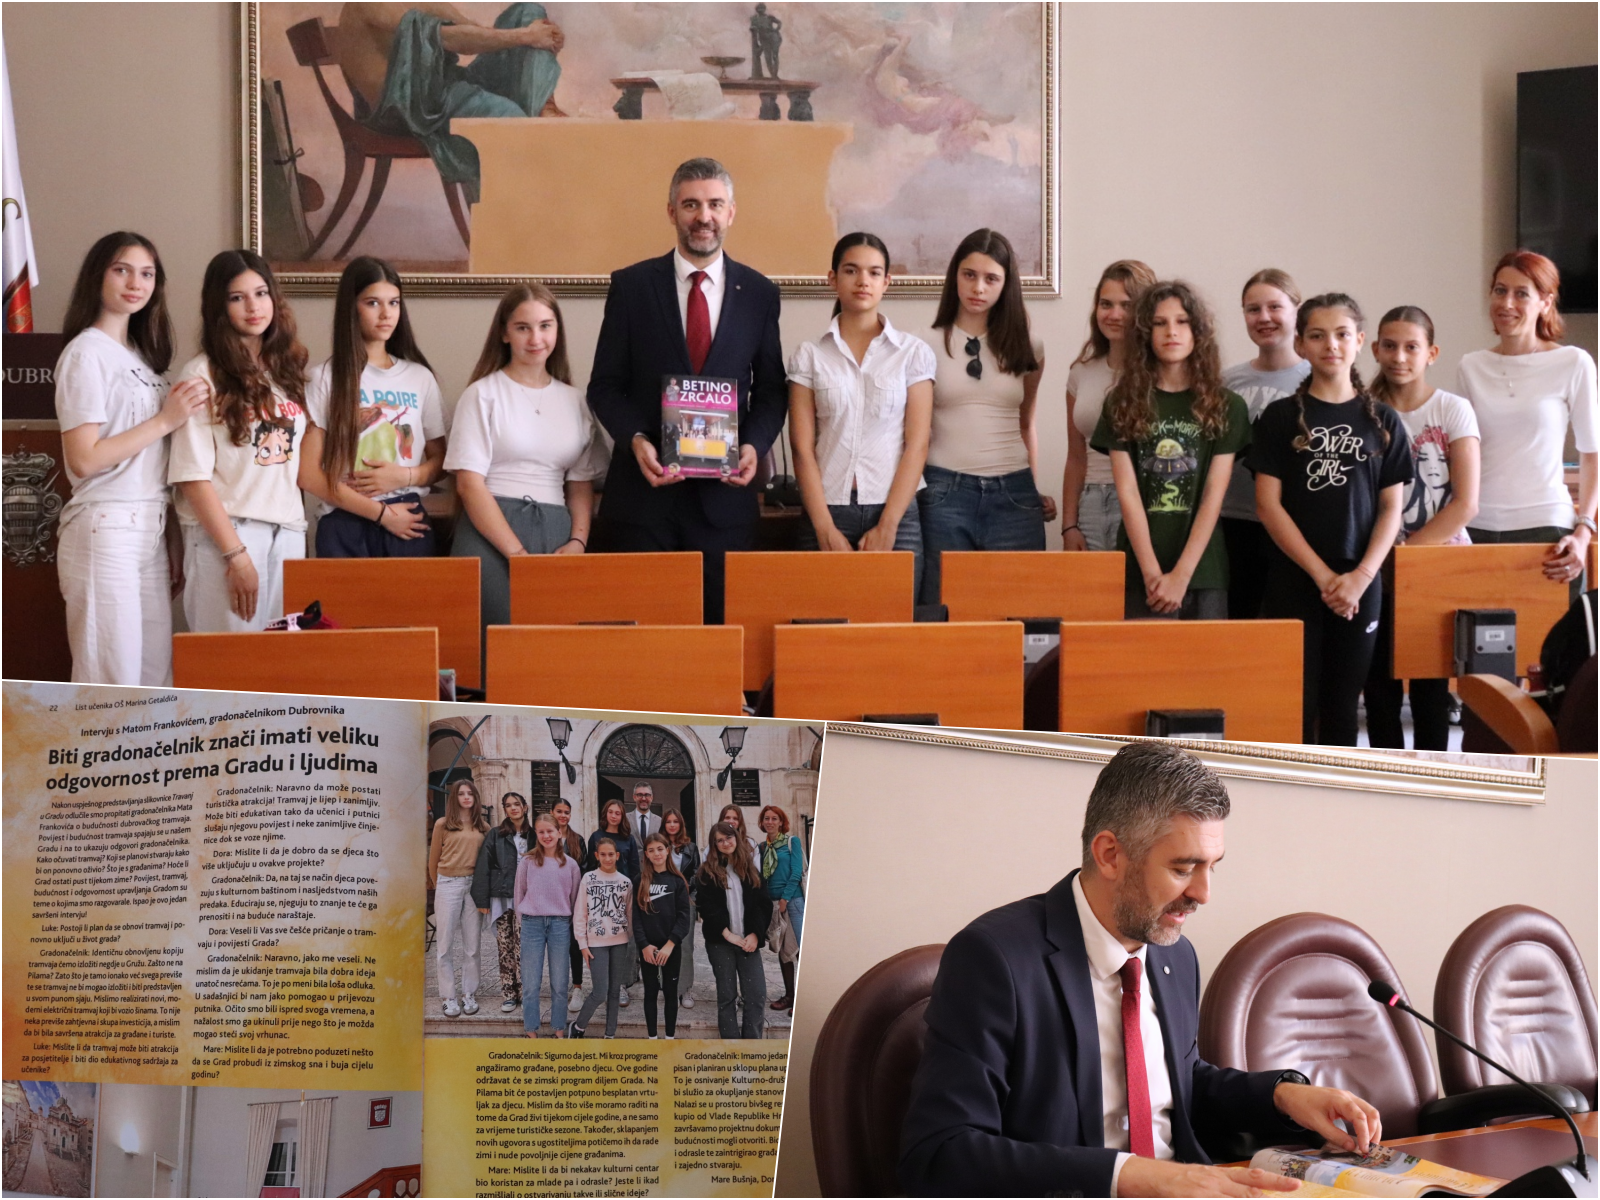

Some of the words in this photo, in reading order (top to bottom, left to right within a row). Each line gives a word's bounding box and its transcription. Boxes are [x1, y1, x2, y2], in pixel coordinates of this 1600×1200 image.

[683, 380, 731, 393] BETINO
[373, 389, 418, 410] POIRE
[679, 391, 732, 405] ZRCALO
[1308, 424, 1368, 462] OWER
[1306, 458, 1348, 491] GIRL
[88, 702, 113, 710] učenika
[114, 700, 124, 708] OŠ
[125, 699, 147, 707] Marina
[148, 695, 178, 705] Getaldića
[81, 727, 114, 738] Intervju
[122, 725, 151, 734] Matom
[153, 718, 207, 730] Frankovićem,
[209, 708, 286, 726] gradonačelnikom
[288, 705, 345, 715] Dubrovnika
[49, 748, 78, 765] Biti
[82, 736, 205, 768] gradonačelnik
[209, 730, 255, 751] znači
[260, 726, 312, 746] imati
[317, 726, 379, 747] veliku
[46, 768, 160, 794] odgovornost
[164, 764, 219, 787] prema
[225, 754, 283, 775] Gradu
[290, 753, 295, 771] i
[301, 753, 377, 776] ljudima
[217, 785, 273, 796] Gradonačelnik:
[314, 783, 324, 791] da
[327, 784, 349, 792] može
[352, 787, 381, 795] postati
[206, 799, 239, 809] turistička
[241, 797, 275, 806] atrakcija!
[277, 796, 308, 805] Tramvaj
[309, 796, 317, 805] je
[319, 795, 337, 805] lijep
[343, 797, 380, 808] zanimljiv.
[240, 810, 282, 818] edukativan
[284, 808, 302, 816] tako
[316, 808, 345, 816] učenici
[353, 811, 380, 819] putnici
[39, 835, 65, 843] Povijest
[69, 833, 104, 841] budućnost
[105, 831, 133, 840] tramvaja
[134, 830, 156, 839] spajaju
[207, 954, 262, 963] Gradonačelnik:
[265, 954, 301, 962] Naravno,
[302, 954, 320, 964] jako
[337, 955, 362, 963] veseli.
[365, 956, 376, 964] Ne
[196, 967, 220, 975] mislim
[222, 967, 231, 975] da
[232, 967, 240, 977] je
[241, 966, 273, 977] ukidanje
[275, 967, 311, 977] tramvaja
[313, 967, 328, 975] bila
[330, 967, 354, 976] dobra
[356, 968, 376, 979] ideja
[53, 1043, 75, 1051] Mislite
[82, 1043, 91, 1052] da
[93, 1045, 117, 1054] tramvaj
[151, 1045, 179, 1055] atrakcija
[488, 1051, 543, 1060] Gradonačelnik:
[544, 1052, 572, 1062] Sigurno
[573, 1052, 582, 1060] da
[582, 1052, 598, 1062] jest.
[609, 1052, 624, 1060] kroz
[625, 1054, 658, 1062] programe
[685, 1052, 739, 1060] Gradonačelnik:
[768, 1052, 788, 1062] jedan
[476, 1064, 521, 1074] angažiramo
[523, 1064, 556, 1074] građane,
[558, 1064, 591, 1074] posebno
[592, 1064, 614, 1074] djecu.
[633, 1064, 658, 1074] godine
[476, 1076, 510, 1084] održavat
[513, 1076, 522, 1084] će
[535, 1076, 559, 1084] zimski
[561, 1078, 593, 1087] program
[595, 1076, 618, 1086] diljem
[620, 1076, 645, 1084] Grada.
[476, 1088, 503, 1097] Pilama
[504, 1089, 515, 1097] bit
[517, 1089, 526, 1097] će
[527, 1089, 567, 1099] postavljen
[569, 1090, 601, 1099] potpuno
[602, 1088, 638, 1098] besplatan
[476, 1101, 490, 1111] ljak
[502, 1101, 525, 1111] djecu.
[527, 1101, 553, 1109] Mislim
[554, 1101, 564, 1109] da
[565, 1101, 578, 1109] što
[579, 1101, 594, 1109] više
[476, 1151, 492, 1159] zimi
[494, 1151, 496, 1159] i
[498, 1151, 518, 1159] nude
[520, 1151, 558, 1161] povoljnije
[560, 1151, 583, 1161] cijene
[584, 1150, 625, 1160] građanima.
[488, 1166, 511, 1174] Mare:
[513, 1166, 540, 1174] Mislite
[542, 1166, 547, 1174] li
[549, 1166, 559, 1174] da
[561, 1166, 568, 1174] bi
[570, 1165, 601, 1174] nekakav
[603, 1165, 633, 1173] kulturni
[679, 1161, 708, 1171] zajedno
[710, 1161, 742, 1171] stvaraju.
[732, 1176, 759, 1185] Bušnja,
